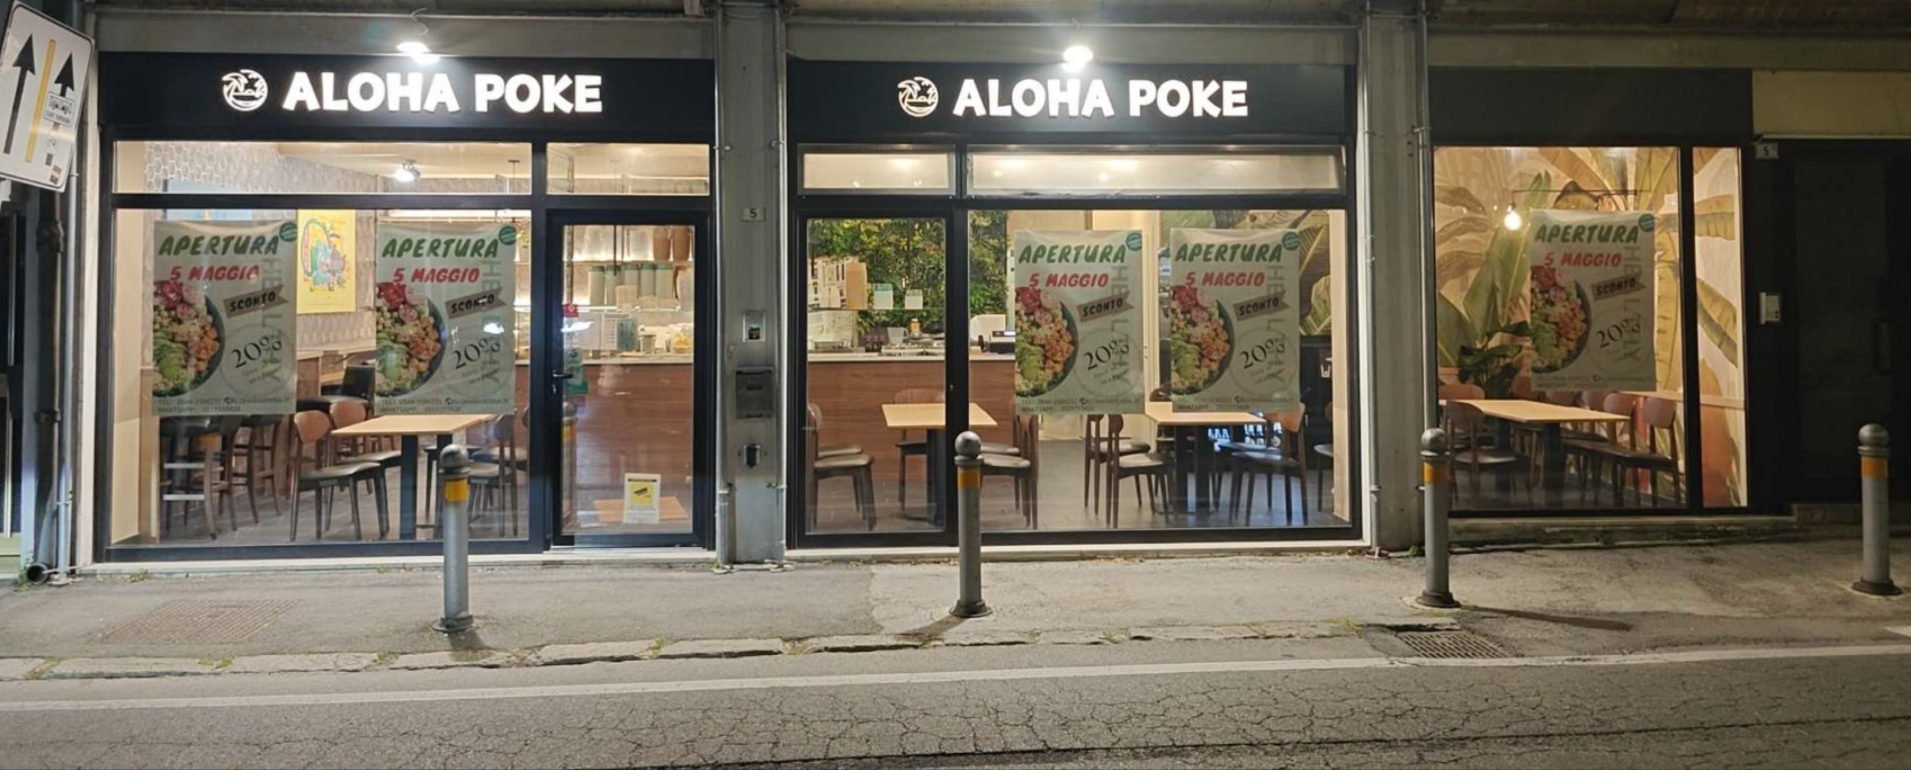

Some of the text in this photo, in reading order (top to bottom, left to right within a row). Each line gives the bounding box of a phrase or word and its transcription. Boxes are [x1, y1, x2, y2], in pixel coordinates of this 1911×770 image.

[282, 71, 603, 114] ALOHA POKE
[952, 78, 1249, 118] ALOHA POKE
[750, 207, 758, 218] 5
[1534, 224, 1639, 244] APERTURA
[158, 234, 280, 256] APERTURA
[381, 238, 499, 259] APERTURA
[1018, 244, 1127, 264] APERTURA
[1175, 243, 1282, 263] APERTURA
[1544, 252, 1622, 267] 5 MAGGIO
[170, 265, 260, 281] 5 MAGGIO
[393, 267, 480, 283] 5 MAGGIO
[1029, 272, 1109, 288] 5 MAGGIO
[1185, 271, 1265, 287] 5 MAGGIO
[1595, 277, 1636, 296] SCONTO
[229, 291, 277, 312] SCONTO
[1083, 297, 1124, 318] SCONTO
[1238, 296, 1280, 316] SCONTO
[1596, 317, 1641, 348] 20%
[231, 335, 283, 369] 20%
[452, 336, 500, 370] 20%
[1084, 339, 1130, 371] 20%
[1239, 338, 1285, 370] 20%
